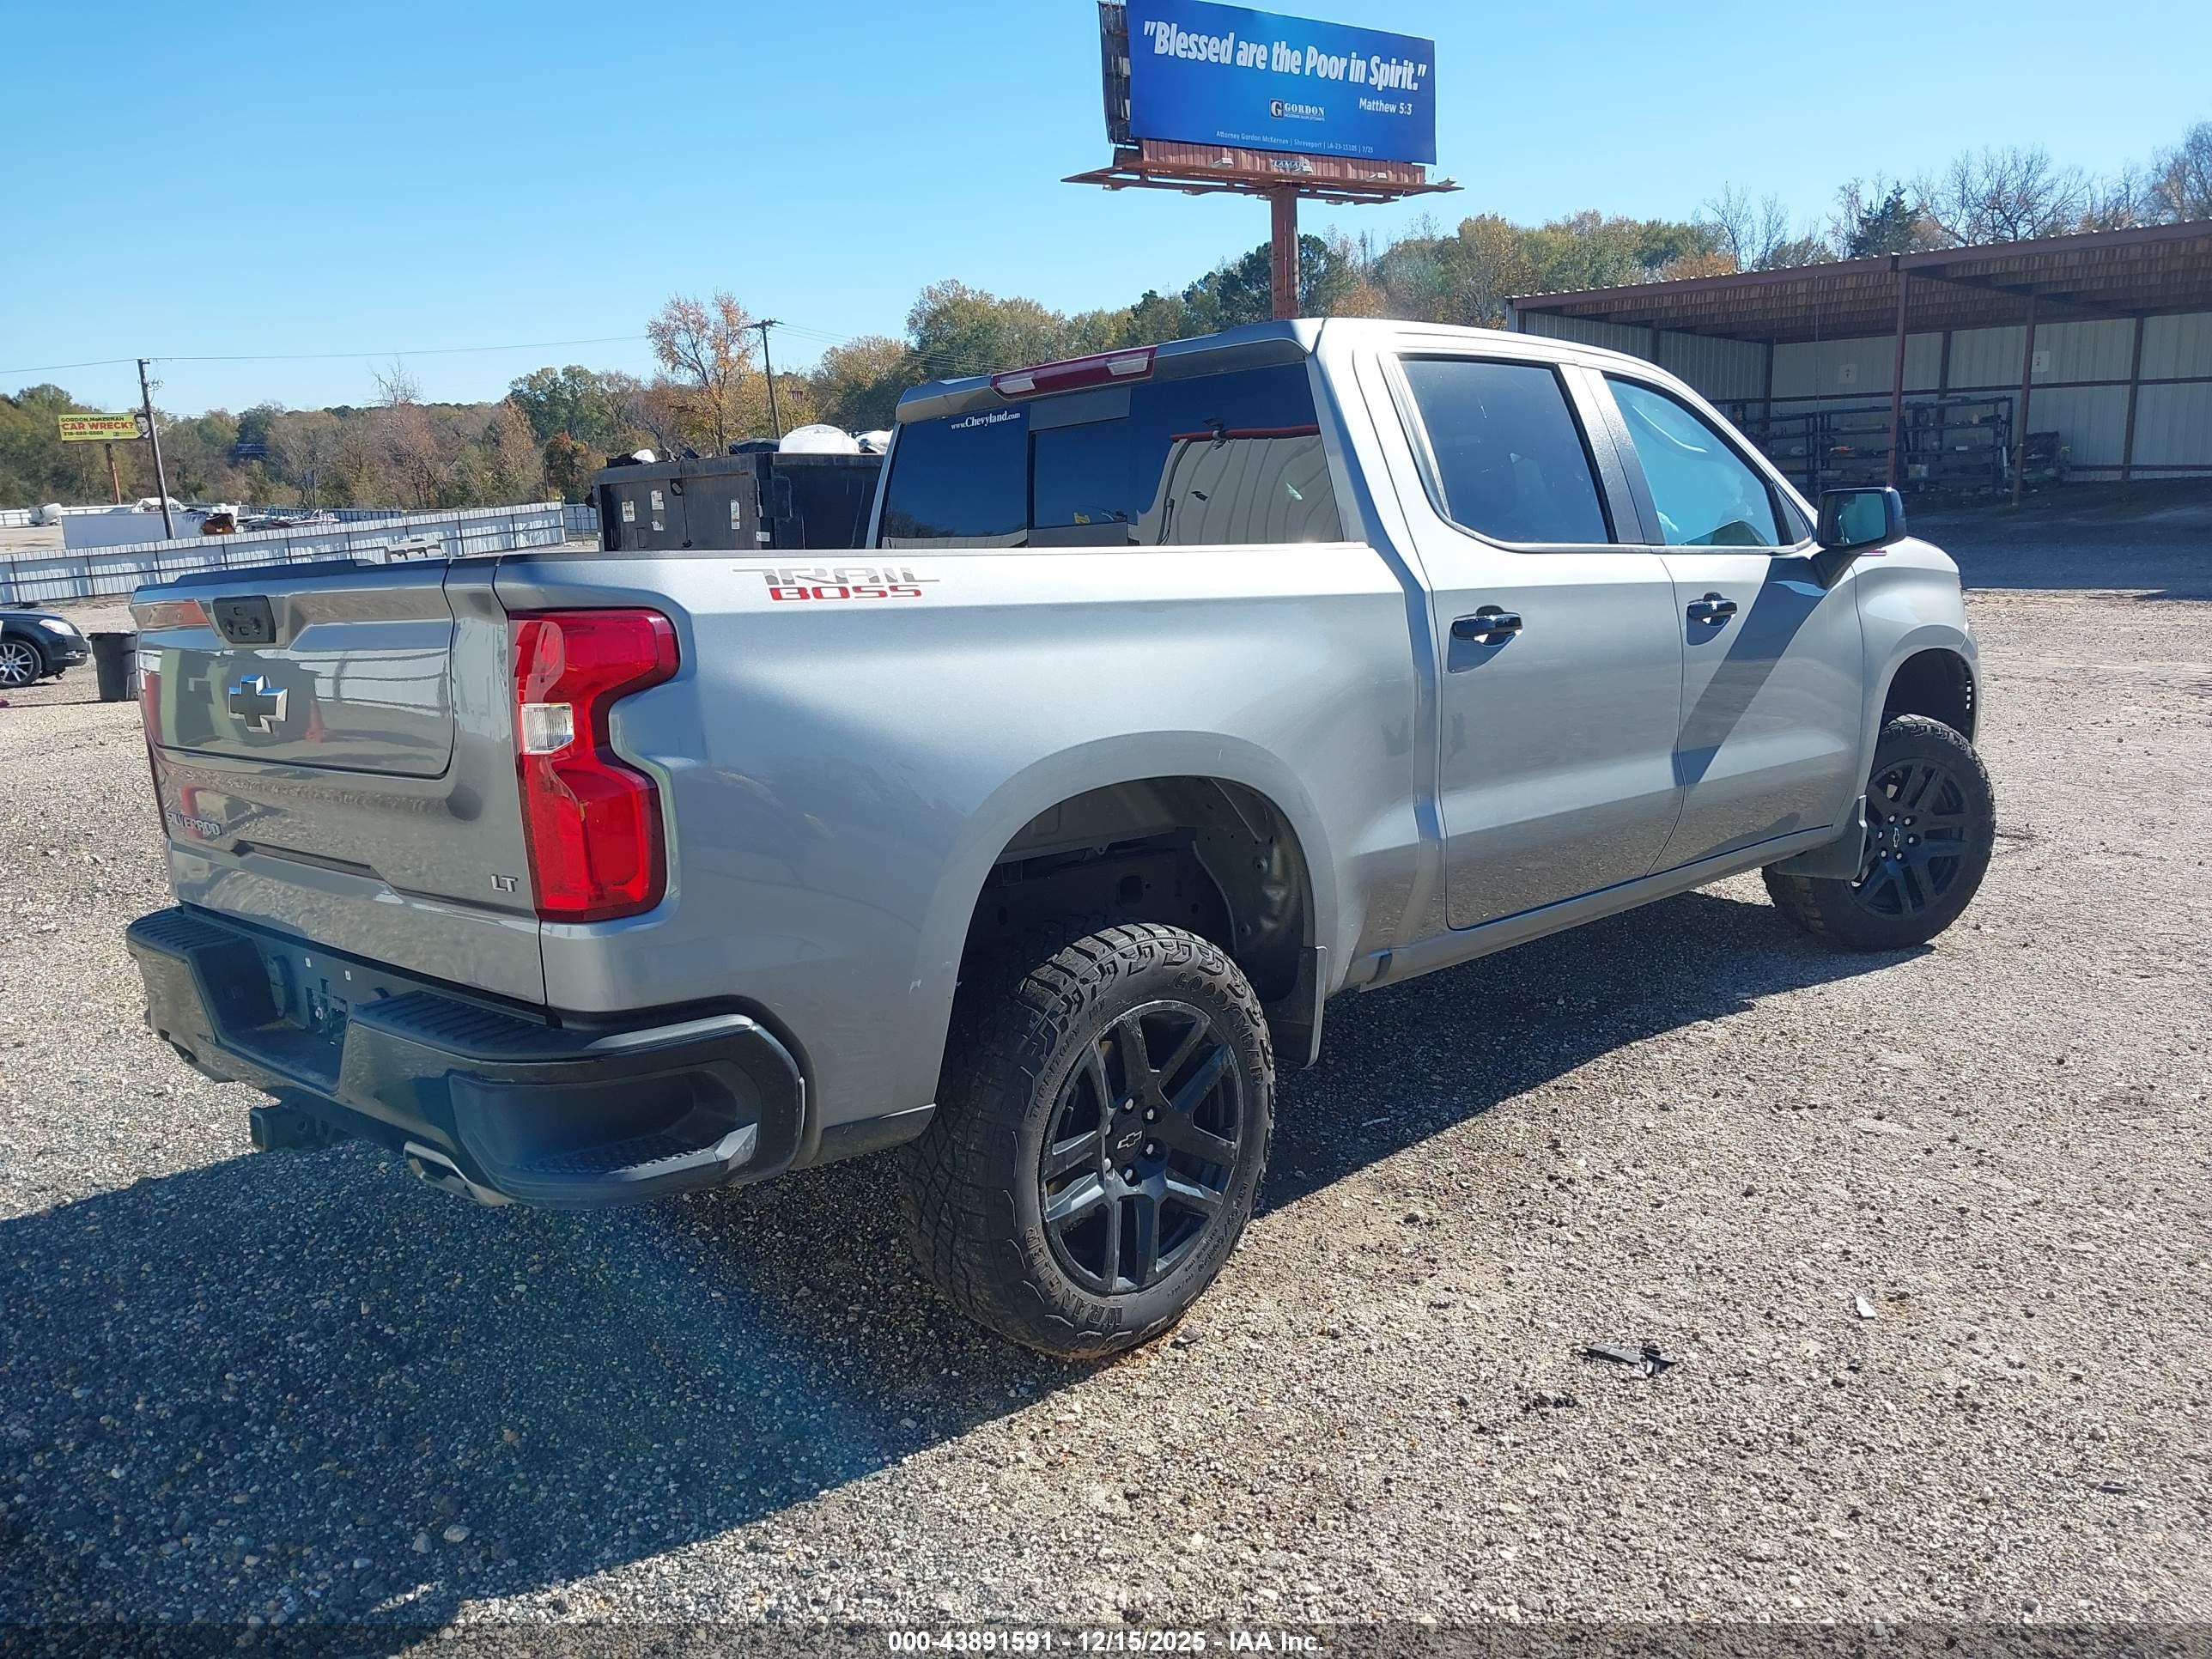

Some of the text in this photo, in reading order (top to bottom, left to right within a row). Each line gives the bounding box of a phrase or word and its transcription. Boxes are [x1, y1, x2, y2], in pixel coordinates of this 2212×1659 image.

[1144, 21, 1427, 91] "Blessed are the Poor in Spirit."
[1285, 102, 1325, 117] GORDON
[1358, 97, 1413, 116] Matthew 5:3
[1216, 131, 1240, 141] Attorney
[1241, 132, 1261, 142] Gordon
[1293, 139, 1322, 149] Shreveport
[88, 421, 134, 430] WRECK?
[732, 568, 940, 586] TRAIL
[769, 585, 922, 601] BOSS
[166, 811, 222, 836] SILVERADO
[491, 874, 518, 893] LT
[1173, 972, 1264, 1086] GOODYEAR
[1024, 1224, 1123, 1327] WRANGLER
